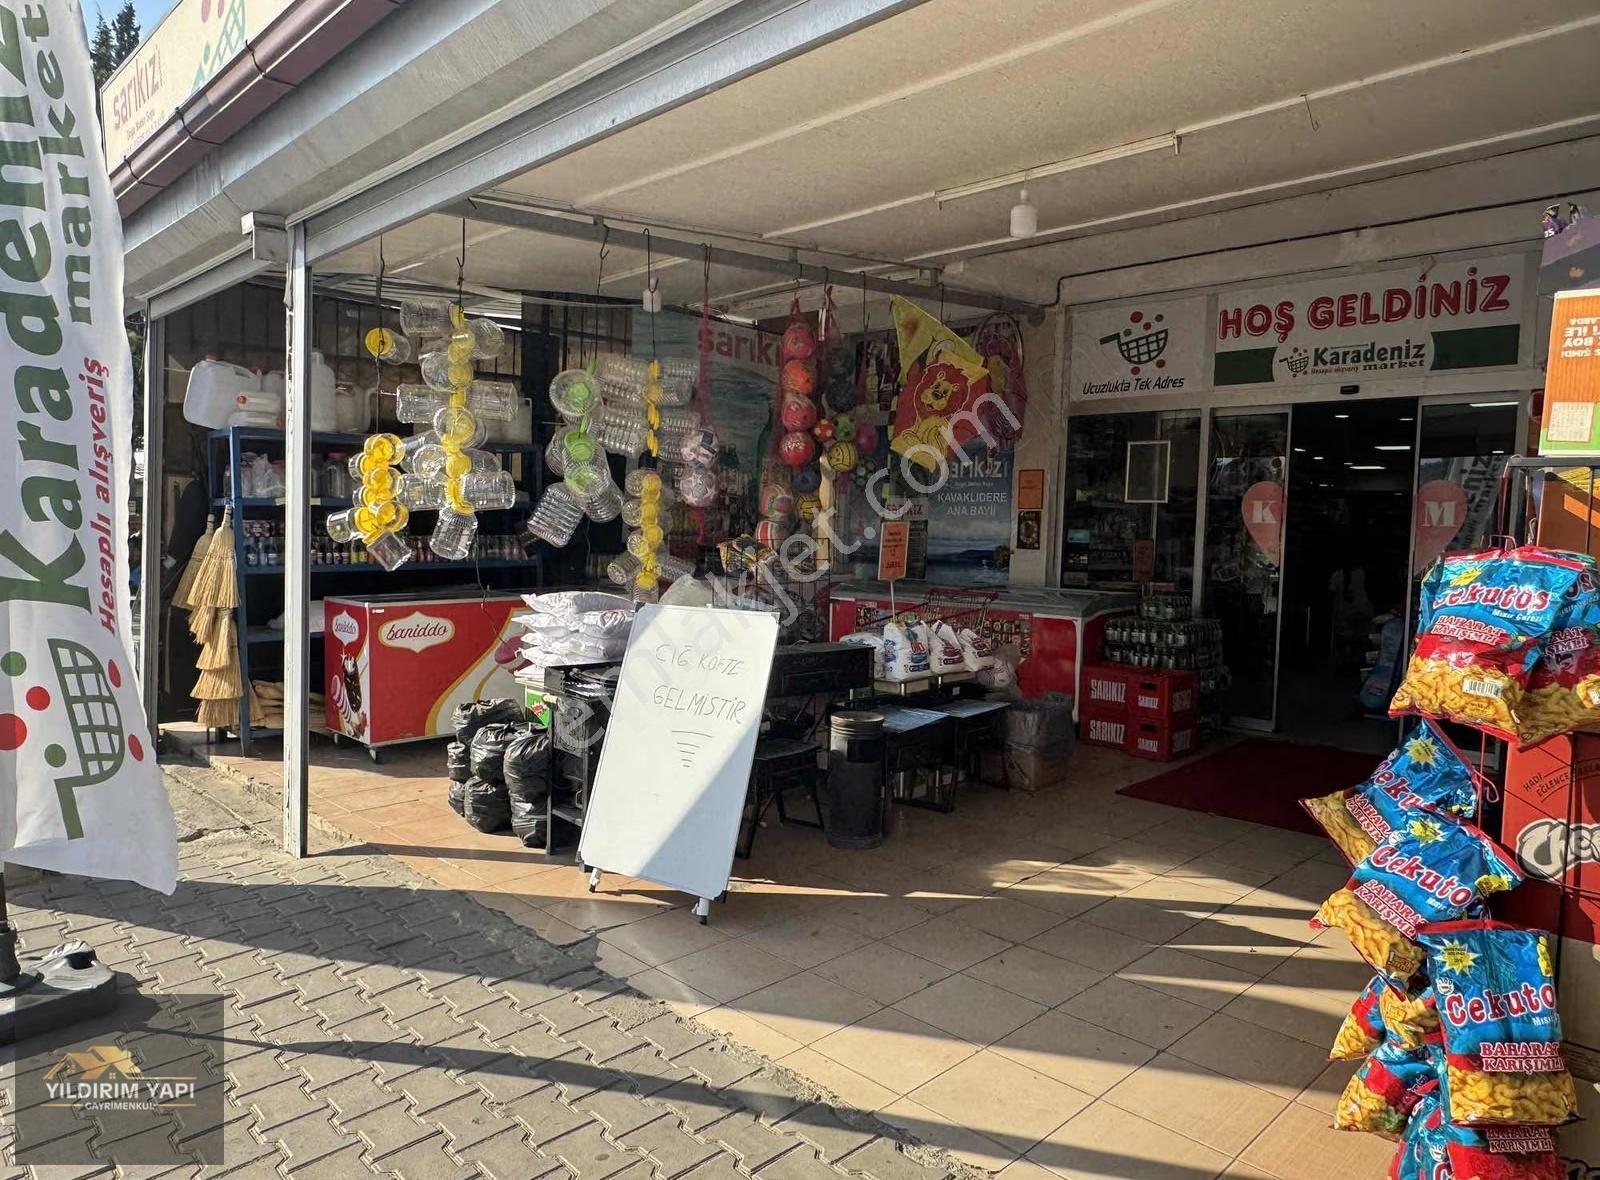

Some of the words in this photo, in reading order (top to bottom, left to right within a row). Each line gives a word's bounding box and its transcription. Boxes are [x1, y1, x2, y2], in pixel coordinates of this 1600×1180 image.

[24, 4, 92, 326] market
[1218, 302, 1295, 343] HOŞ
[1306, 266, 1511, 330] GELDİNİZ
[1313, 339, 1426, 367] Karadeniz
[1362, 359, 1426, 371] market
[1083, 379, 1131, 395] Ucuzlukta
[1133, 377, 1152, 391] Tek
[1152, 375, 1185, 389] Adres
[83, 356, 115, 504] alışveriş
[1252, 501, 1277, 524] K
[1420, 501, 1458, 527] M
[89, 513, 117, 636] Hesaplı
[1090, 679, 1126, 703] SARIKIZ
[1089, 719, 1126, 745] SARIKIZ
[1371, 845, 1472, 906] Cekuto
[1445, 983, 1557, 1027] Cekuto
